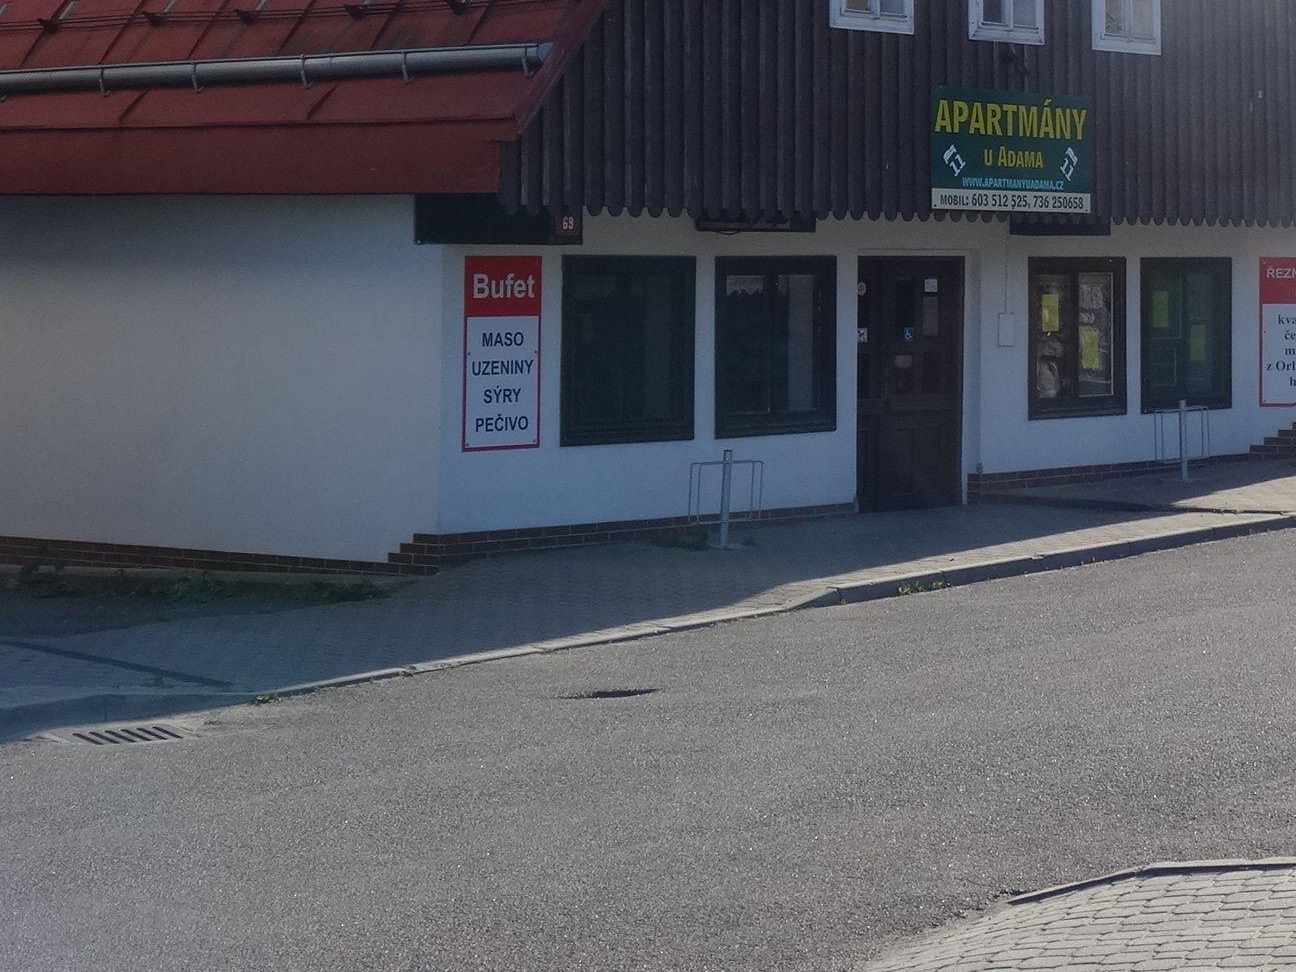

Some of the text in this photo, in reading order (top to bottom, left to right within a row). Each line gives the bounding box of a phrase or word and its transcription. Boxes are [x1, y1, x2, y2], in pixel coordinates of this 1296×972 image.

[935, 99, 1087, 140] APARTMÁNY
[998, 146, 1044, 169] ADAMA
[940, 195, 969, 206] MOBIL:
[971, 193, 989, 207] 603
[992, 194, 1008, 208] 512
[1033, 196, 1050, 209] 736
[1052, 196, 1084, 210] 250658
[473, 273, 535, 299] Bufet
[482, 332, 524, 347] MASO
[472, 359, 534, 376] UZENINY
[1266, 363, 1272, 371] z
[484, 385, 522, 404] SÝRY
[475, 413, 529, 433] PEČIVO
